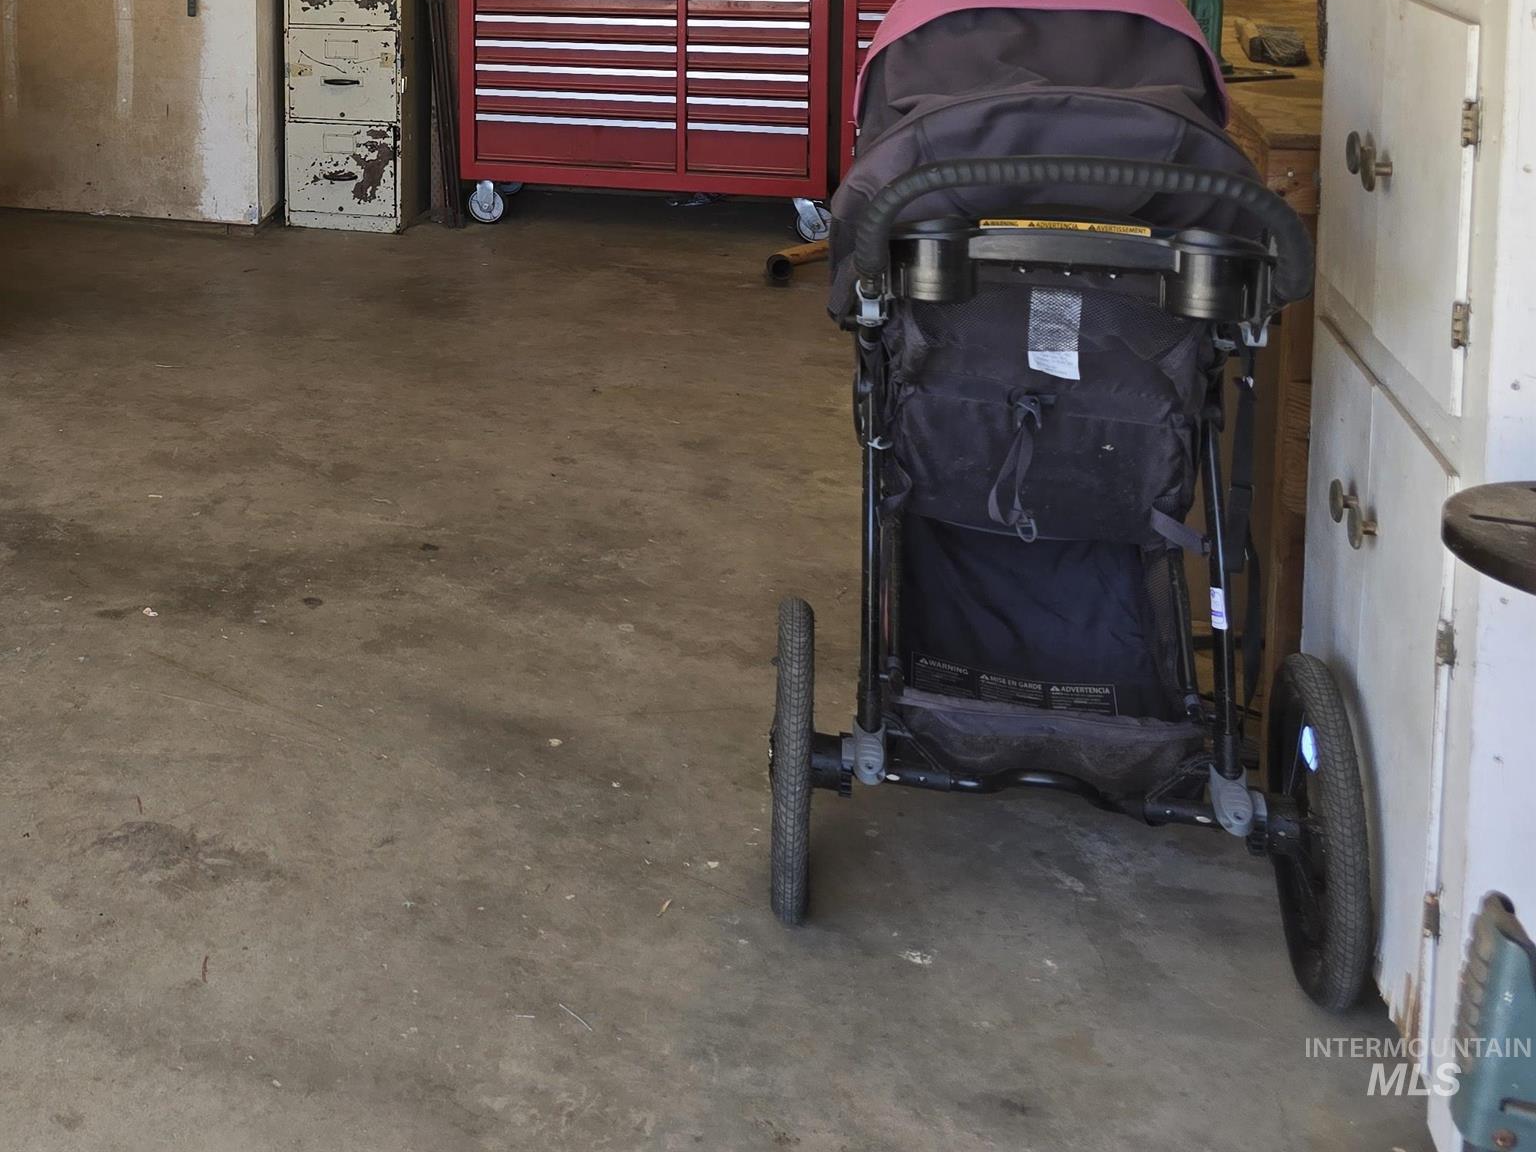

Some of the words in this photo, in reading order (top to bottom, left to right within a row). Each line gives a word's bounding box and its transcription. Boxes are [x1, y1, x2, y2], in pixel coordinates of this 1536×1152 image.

[1036, 222, 1078, 230] ADVERTENCIA
[1096, 225, 1147, 235] AVERTISSEMENT
[928, 659, 969, 675] WARNING
[989, 675, 1007, 685] MISE
[1007, 679, 1018, 688] EN
[1018, 681, 1043, 691] GARDE
[1060, 686, 1110, 695] ADVERTENCIA
